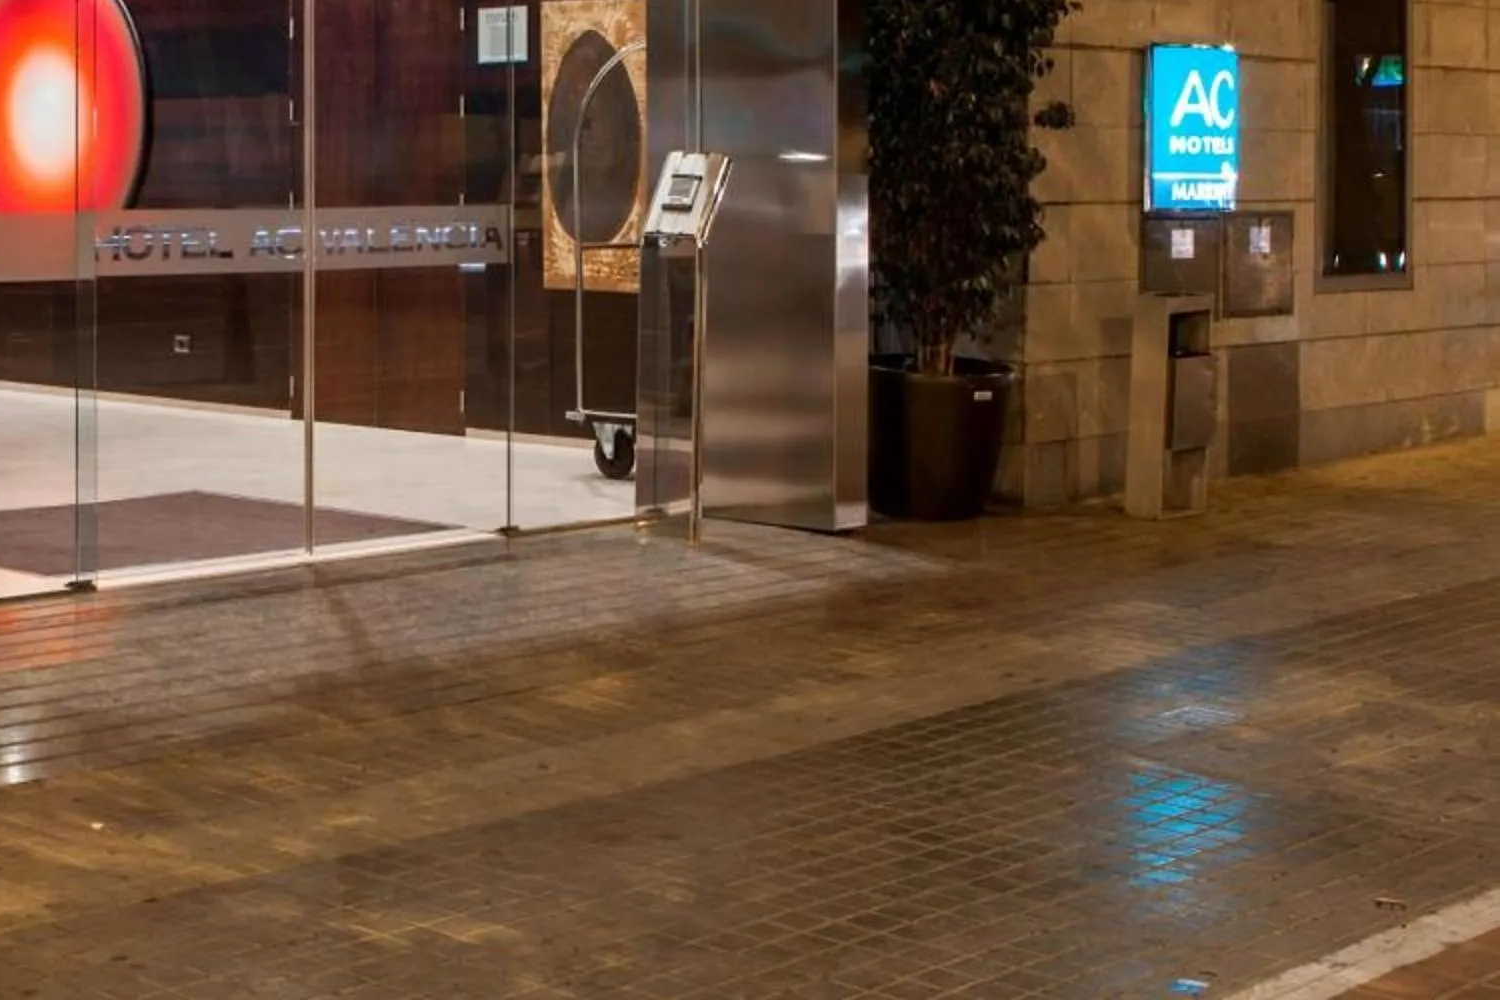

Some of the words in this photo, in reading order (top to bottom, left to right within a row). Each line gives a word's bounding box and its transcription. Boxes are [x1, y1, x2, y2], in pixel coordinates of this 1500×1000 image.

[1169, 69, 1235, 130] AC
[95, 224, 234, 261] HOTEL
[250, 228, 302, 257] AC
[318, 220, 505, 255] VALENCIA
